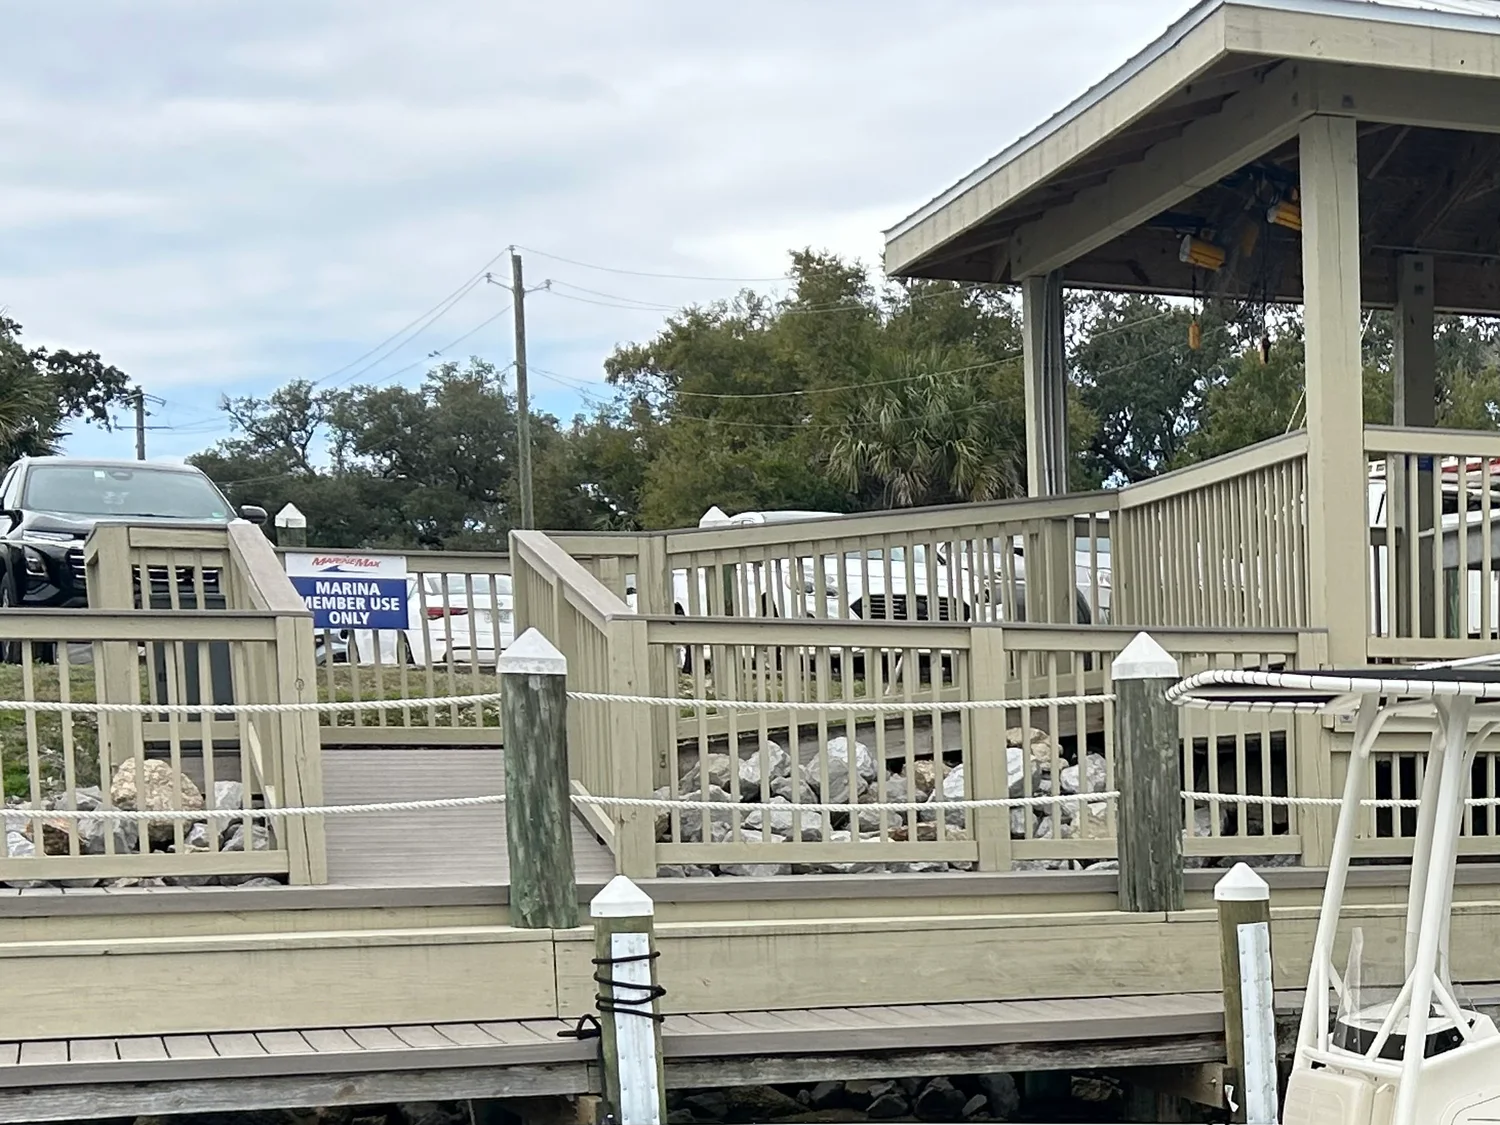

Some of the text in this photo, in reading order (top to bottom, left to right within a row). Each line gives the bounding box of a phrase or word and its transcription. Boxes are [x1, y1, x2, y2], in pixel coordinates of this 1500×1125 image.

[315, 581, 381, 596] MARINA
[370, 597, 400, 611] USE
[328, 611, 370, 625] ONLY
